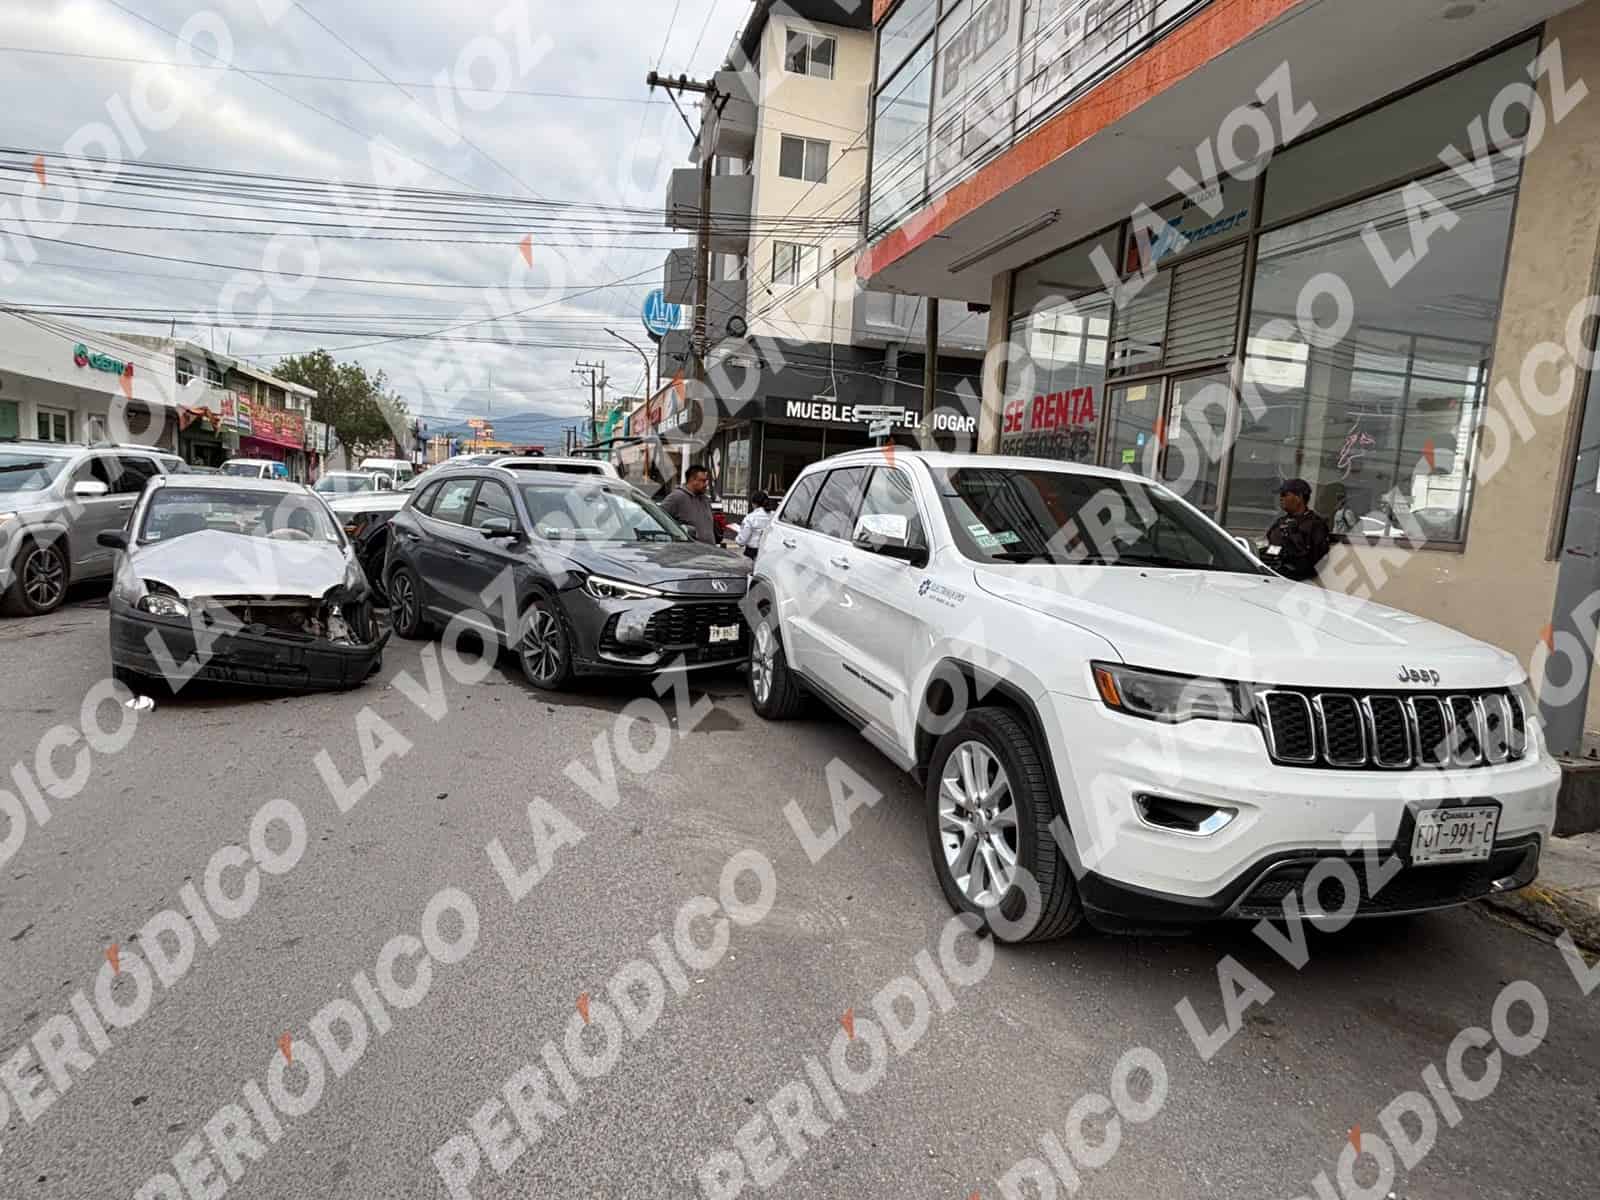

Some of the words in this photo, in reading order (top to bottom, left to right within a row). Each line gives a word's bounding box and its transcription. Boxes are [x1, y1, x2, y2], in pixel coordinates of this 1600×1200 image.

[1003, 400, 1024, 433] SE
[1032, 386, 1095, 430] RENTA
[1398, 664, 1441, 687] Jeep
